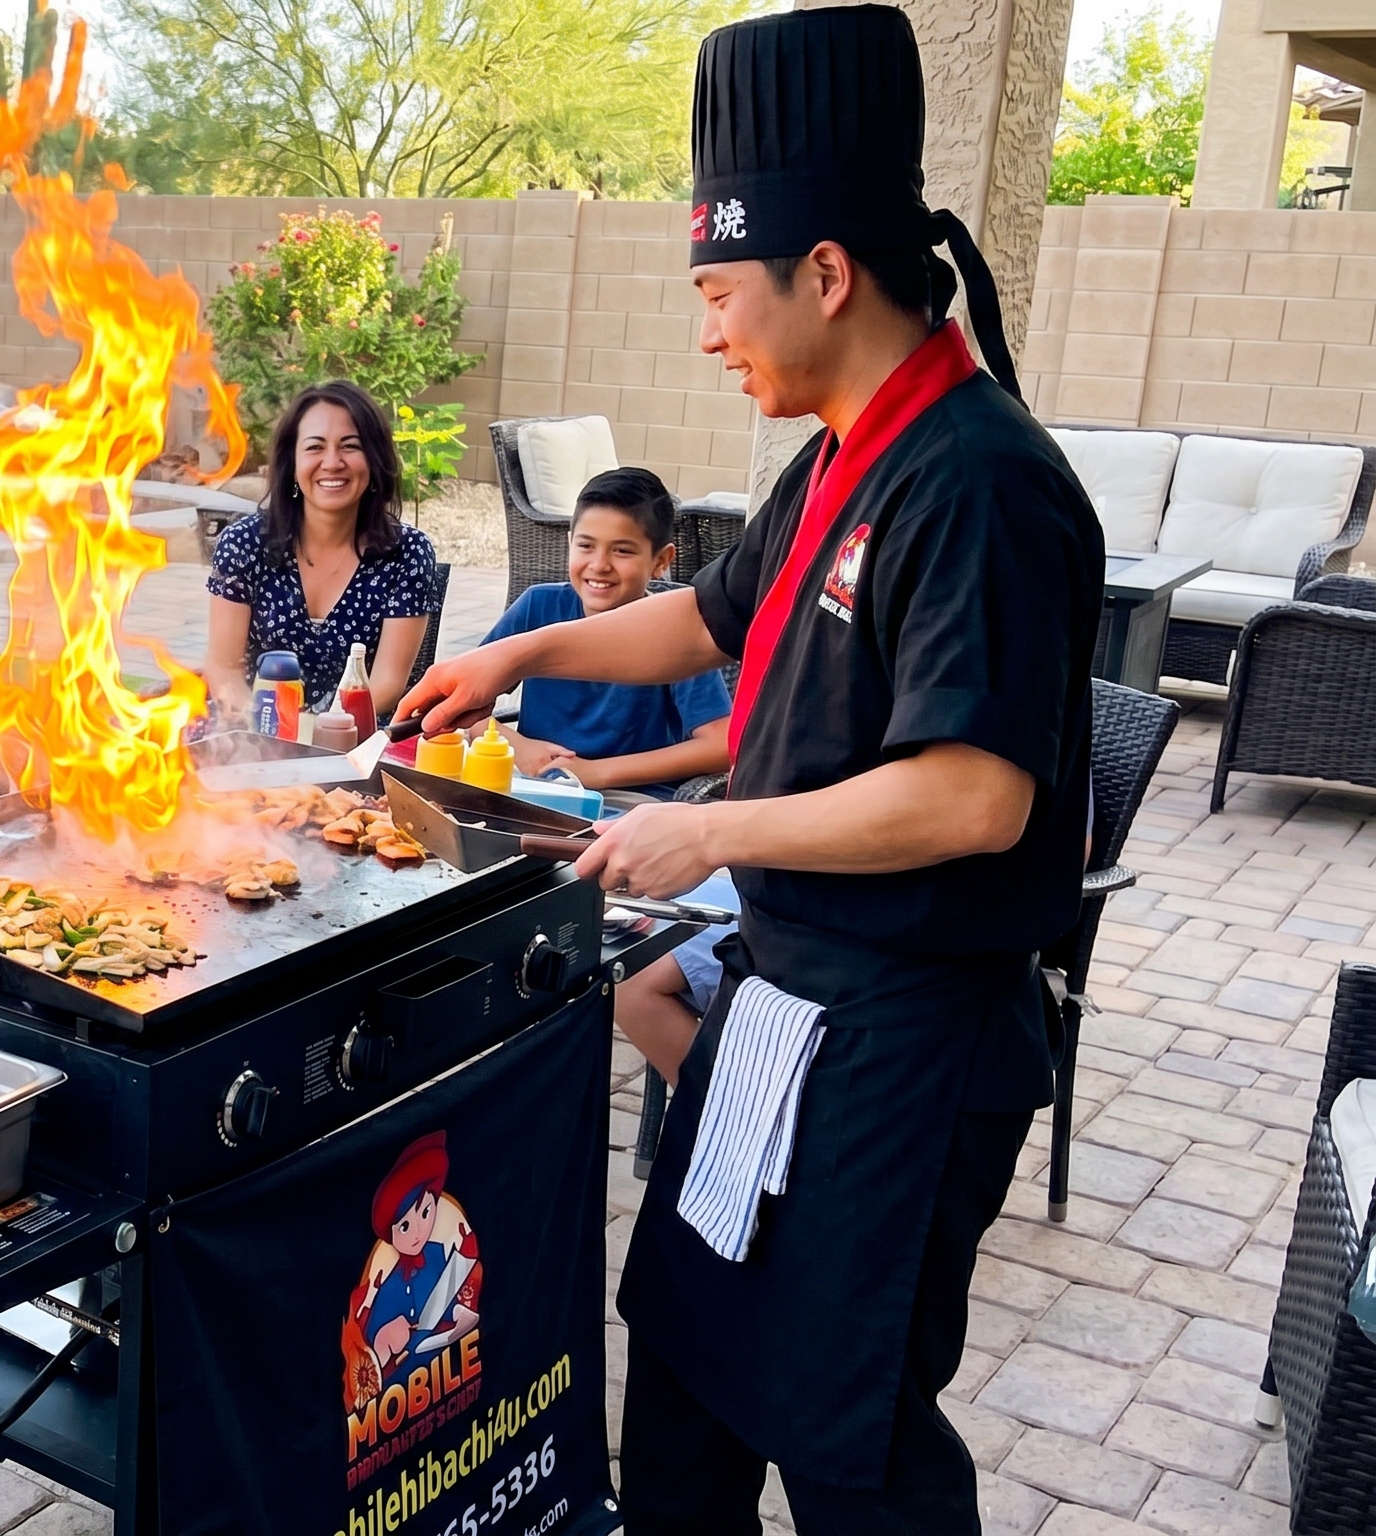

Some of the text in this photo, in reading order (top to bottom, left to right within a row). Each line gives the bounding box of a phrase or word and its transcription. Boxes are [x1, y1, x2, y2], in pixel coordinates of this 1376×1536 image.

[334, 1354, 571, 1536] bilehibachi4u.com
[347, 1329, 482, 1463] MOBILE
[437, 1434, 556, 1536] 5-5336
